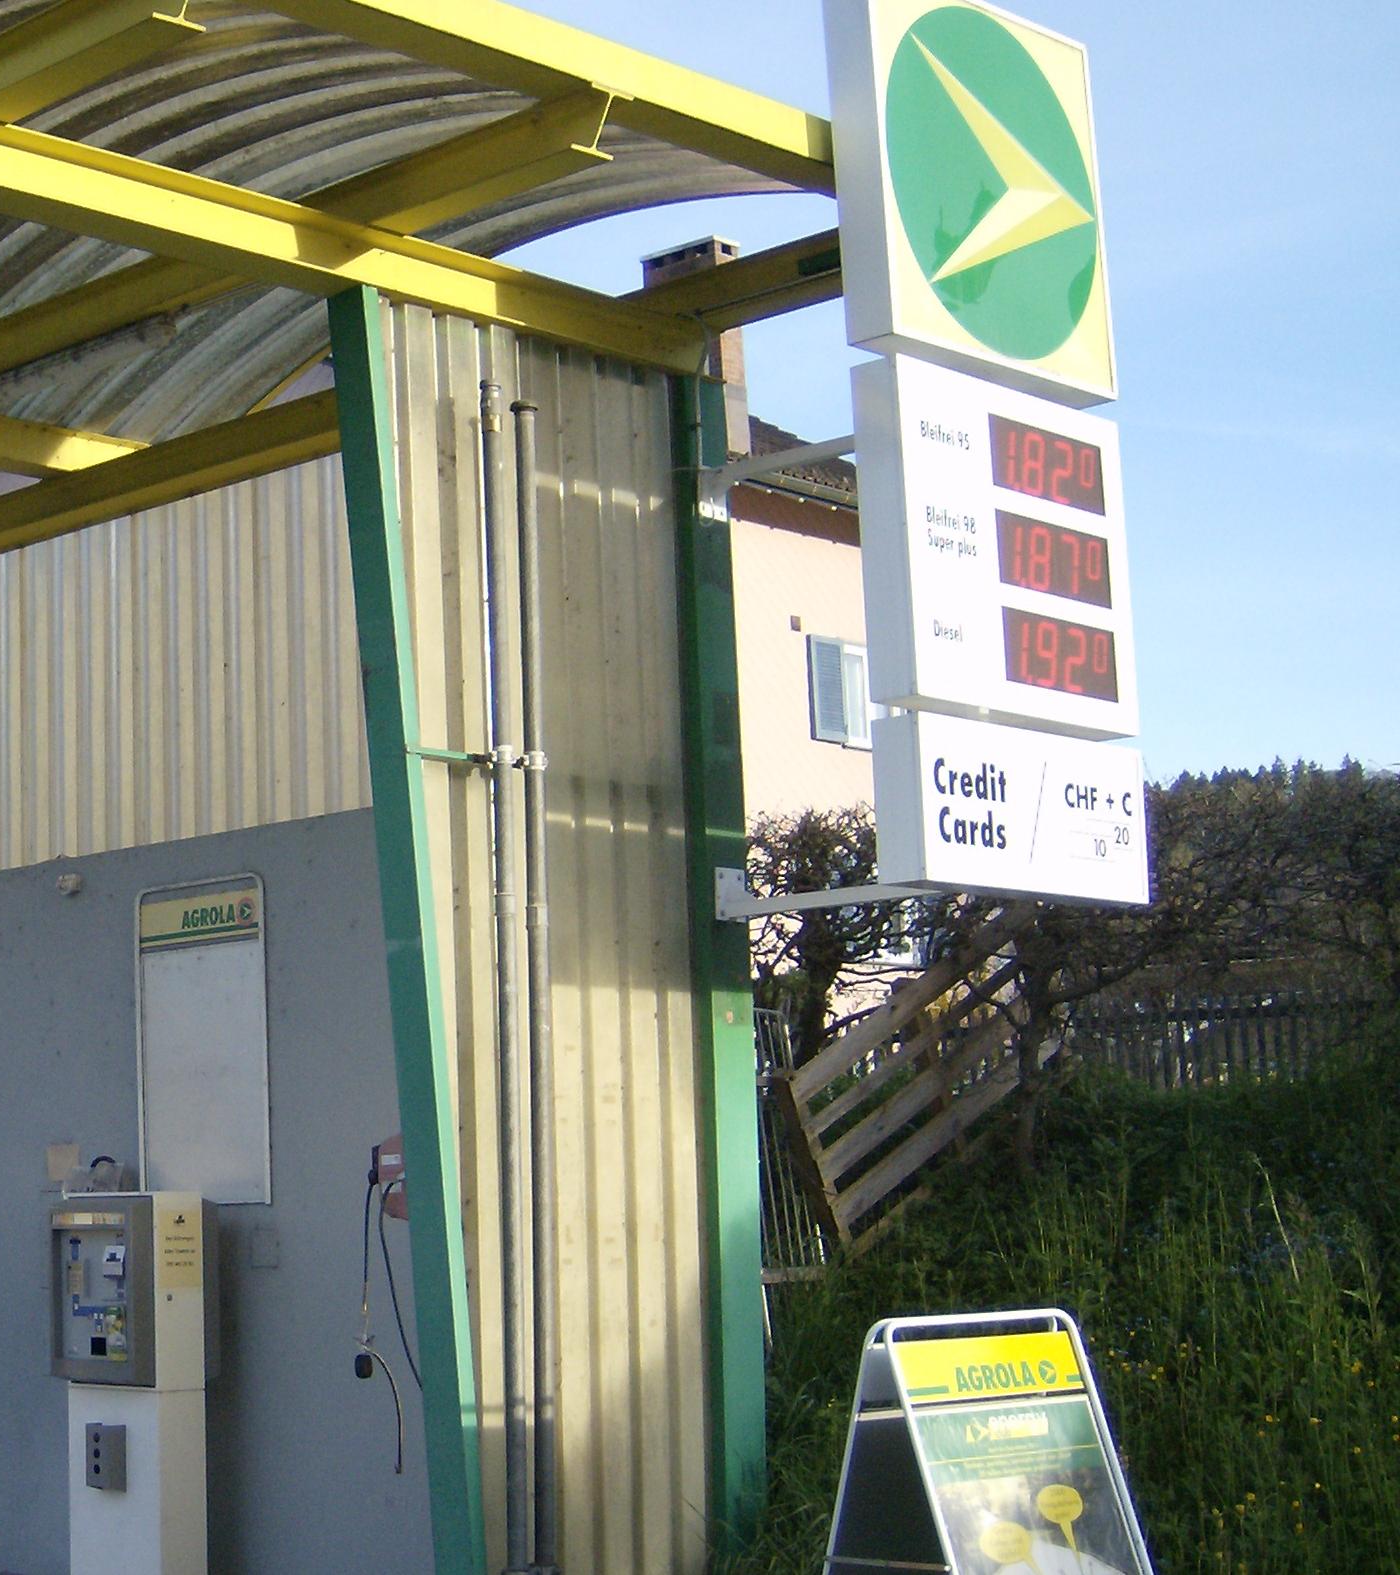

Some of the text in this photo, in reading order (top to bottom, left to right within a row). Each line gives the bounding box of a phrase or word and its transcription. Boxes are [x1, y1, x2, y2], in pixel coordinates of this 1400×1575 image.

[920, 419, 969, 450] Bleifrei 95
[926, 505, 976, 534] Bleifrei 98
[927, 528, 977, 558] Super plus
[933, 619, 963, 642] Diesel
[933, 757, 1007, 803] Credit
[1065, 783, 1098, 810] CHF
[939, 805, 1007, 850] Cards
[1114, 826, 1130, 845] 20
[1094, 838, 1107, 857] 10
[181, 903, 236, 930] AGROLA
[955, 1360, 1037, 1393] AGROLA
